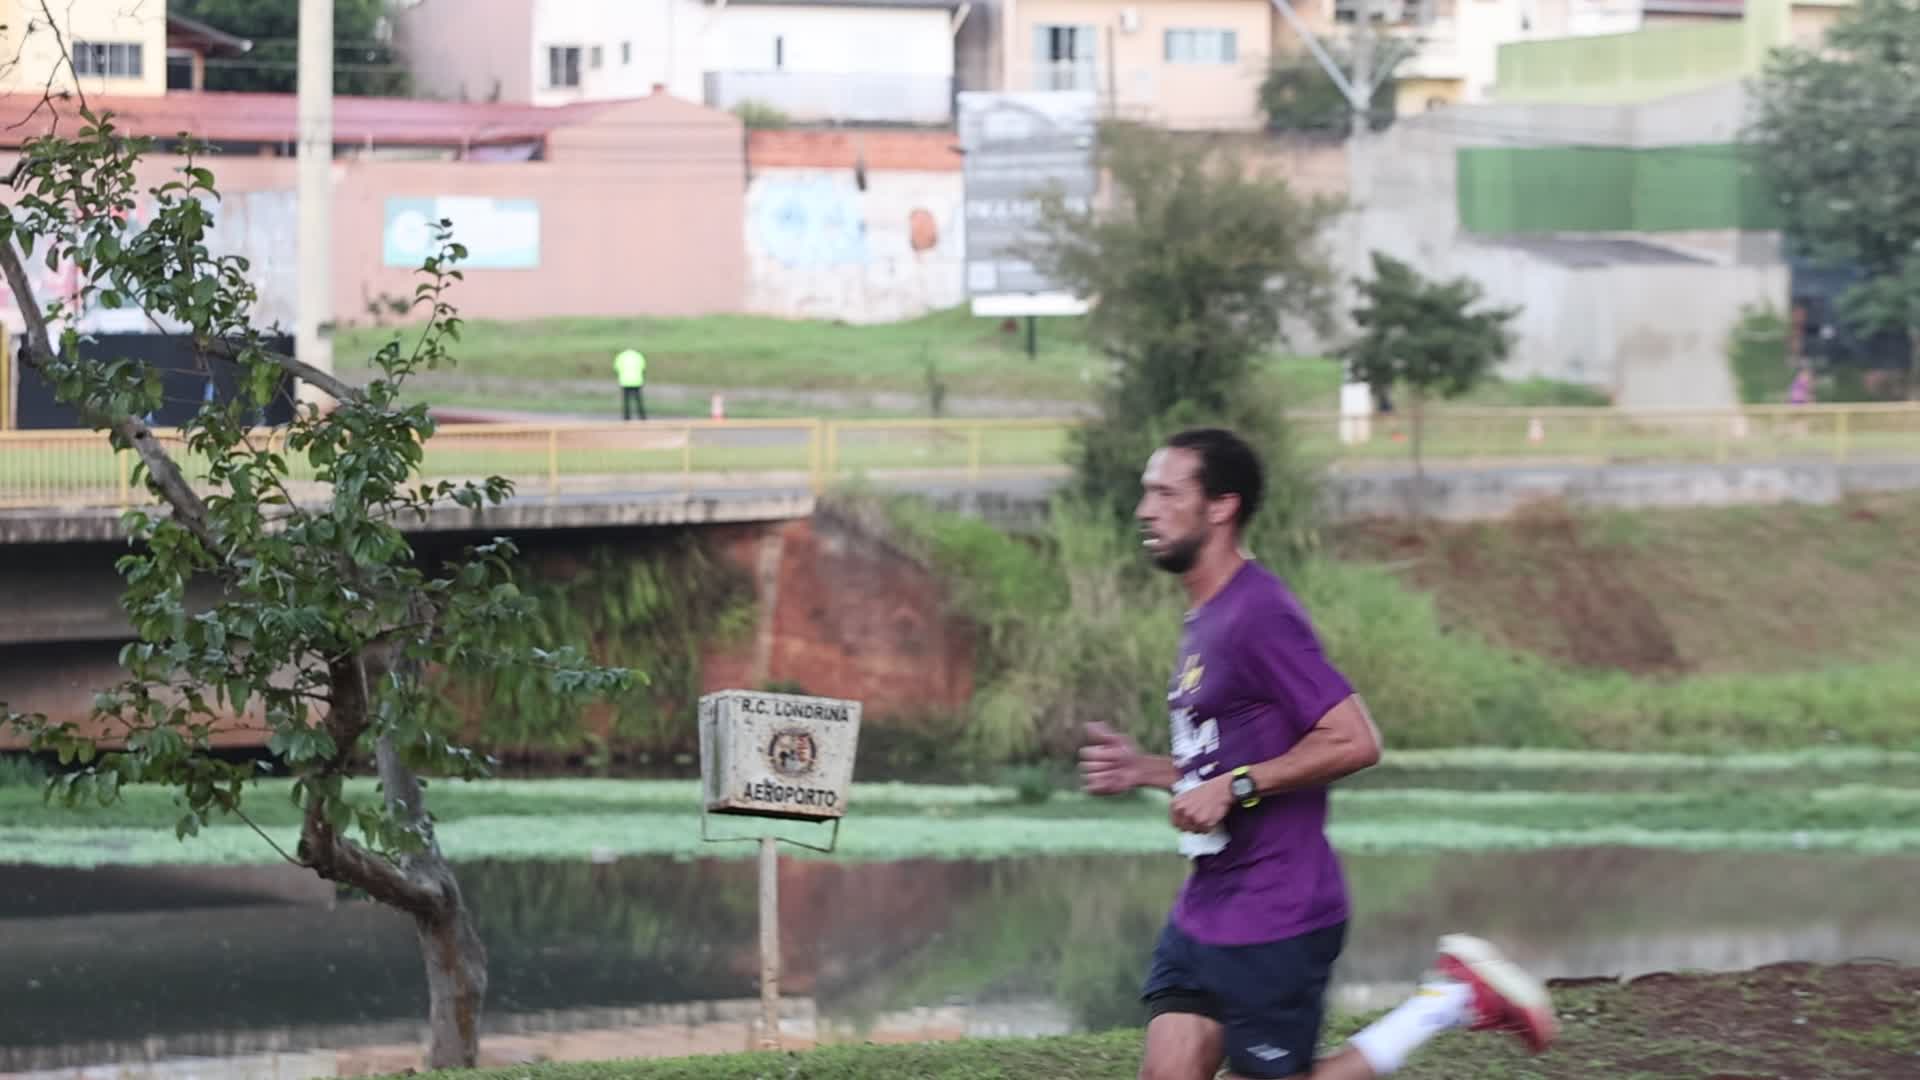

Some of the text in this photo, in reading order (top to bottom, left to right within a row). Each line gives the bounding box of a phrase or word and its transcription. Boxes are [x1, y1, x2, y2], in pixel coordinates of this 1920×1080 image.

[741, 699, 849, 722] R.C. LONDRINA
[743, 782, 837, 807] AEROPORTO
